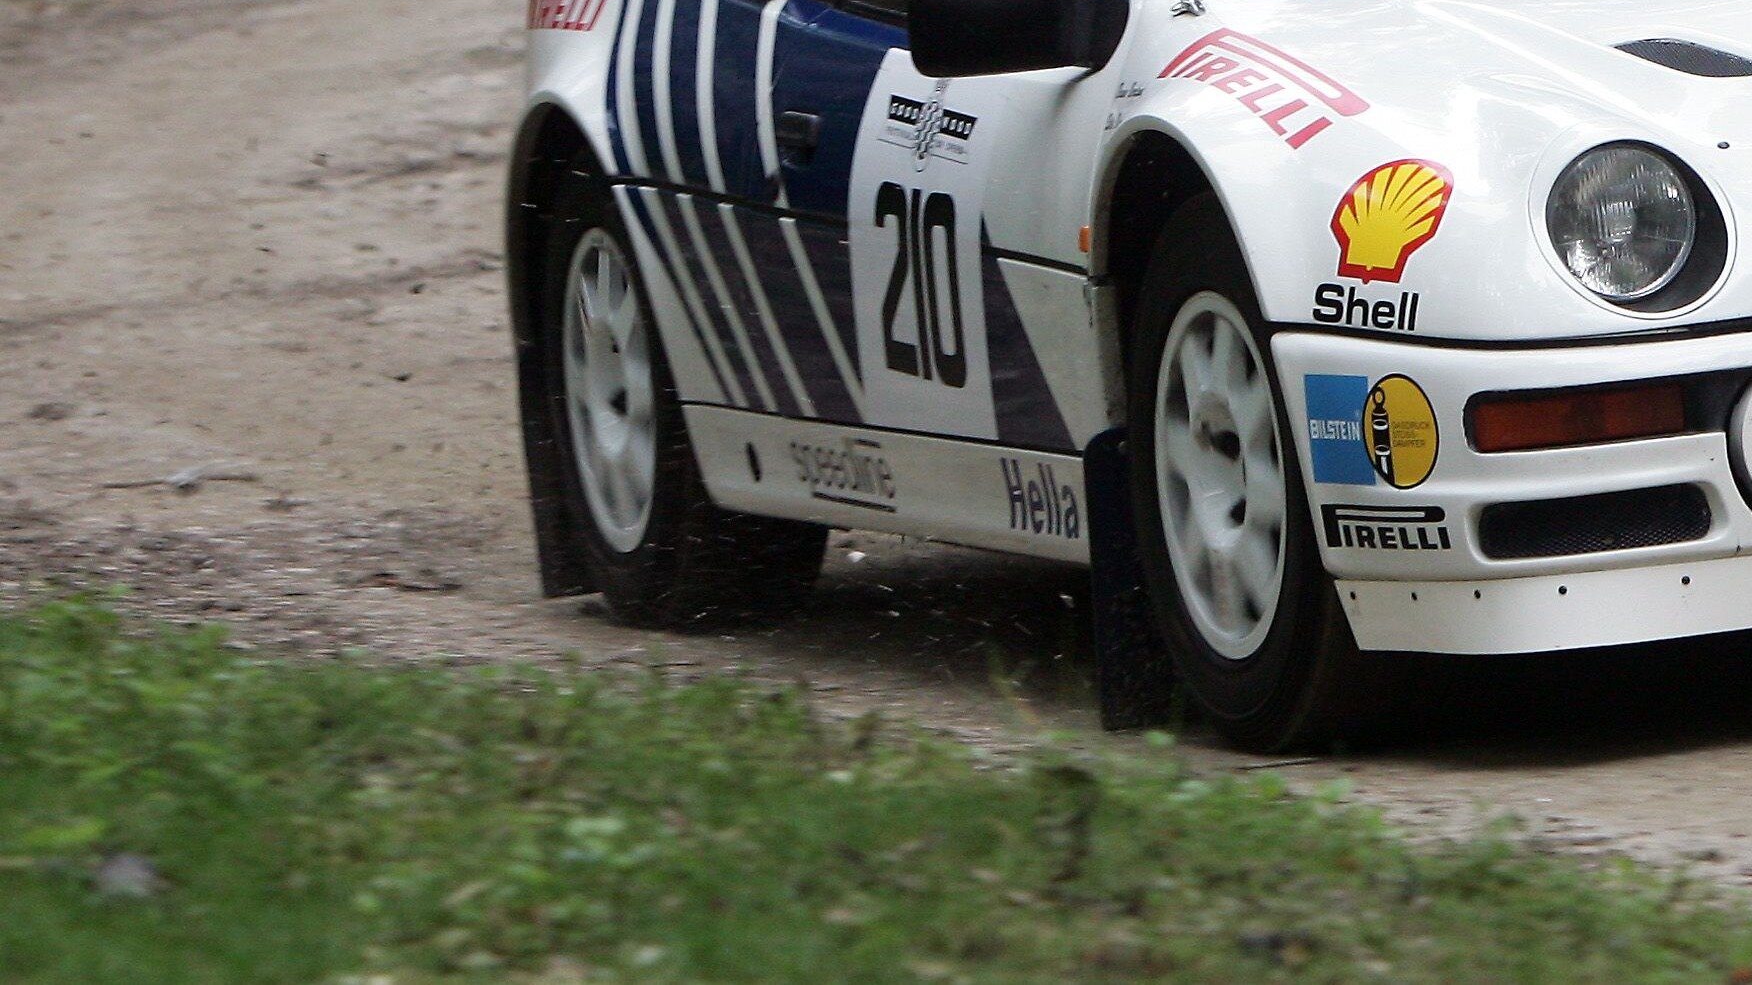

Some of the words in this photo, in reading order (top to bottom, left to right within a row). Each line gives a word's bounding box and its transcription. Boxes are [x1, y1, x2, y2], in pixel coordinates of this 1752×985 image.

[1156, 27, 1371, 150] PIRELLI
[874, 181, 967, 388] 210
[1312, 282, 1419, 331] Shell
[1309, 419, 1361, 441] BILSTEIN
[1001, 457, 1081, 539] Hella
[1320, 504, 1451, 550] PIRELLI
